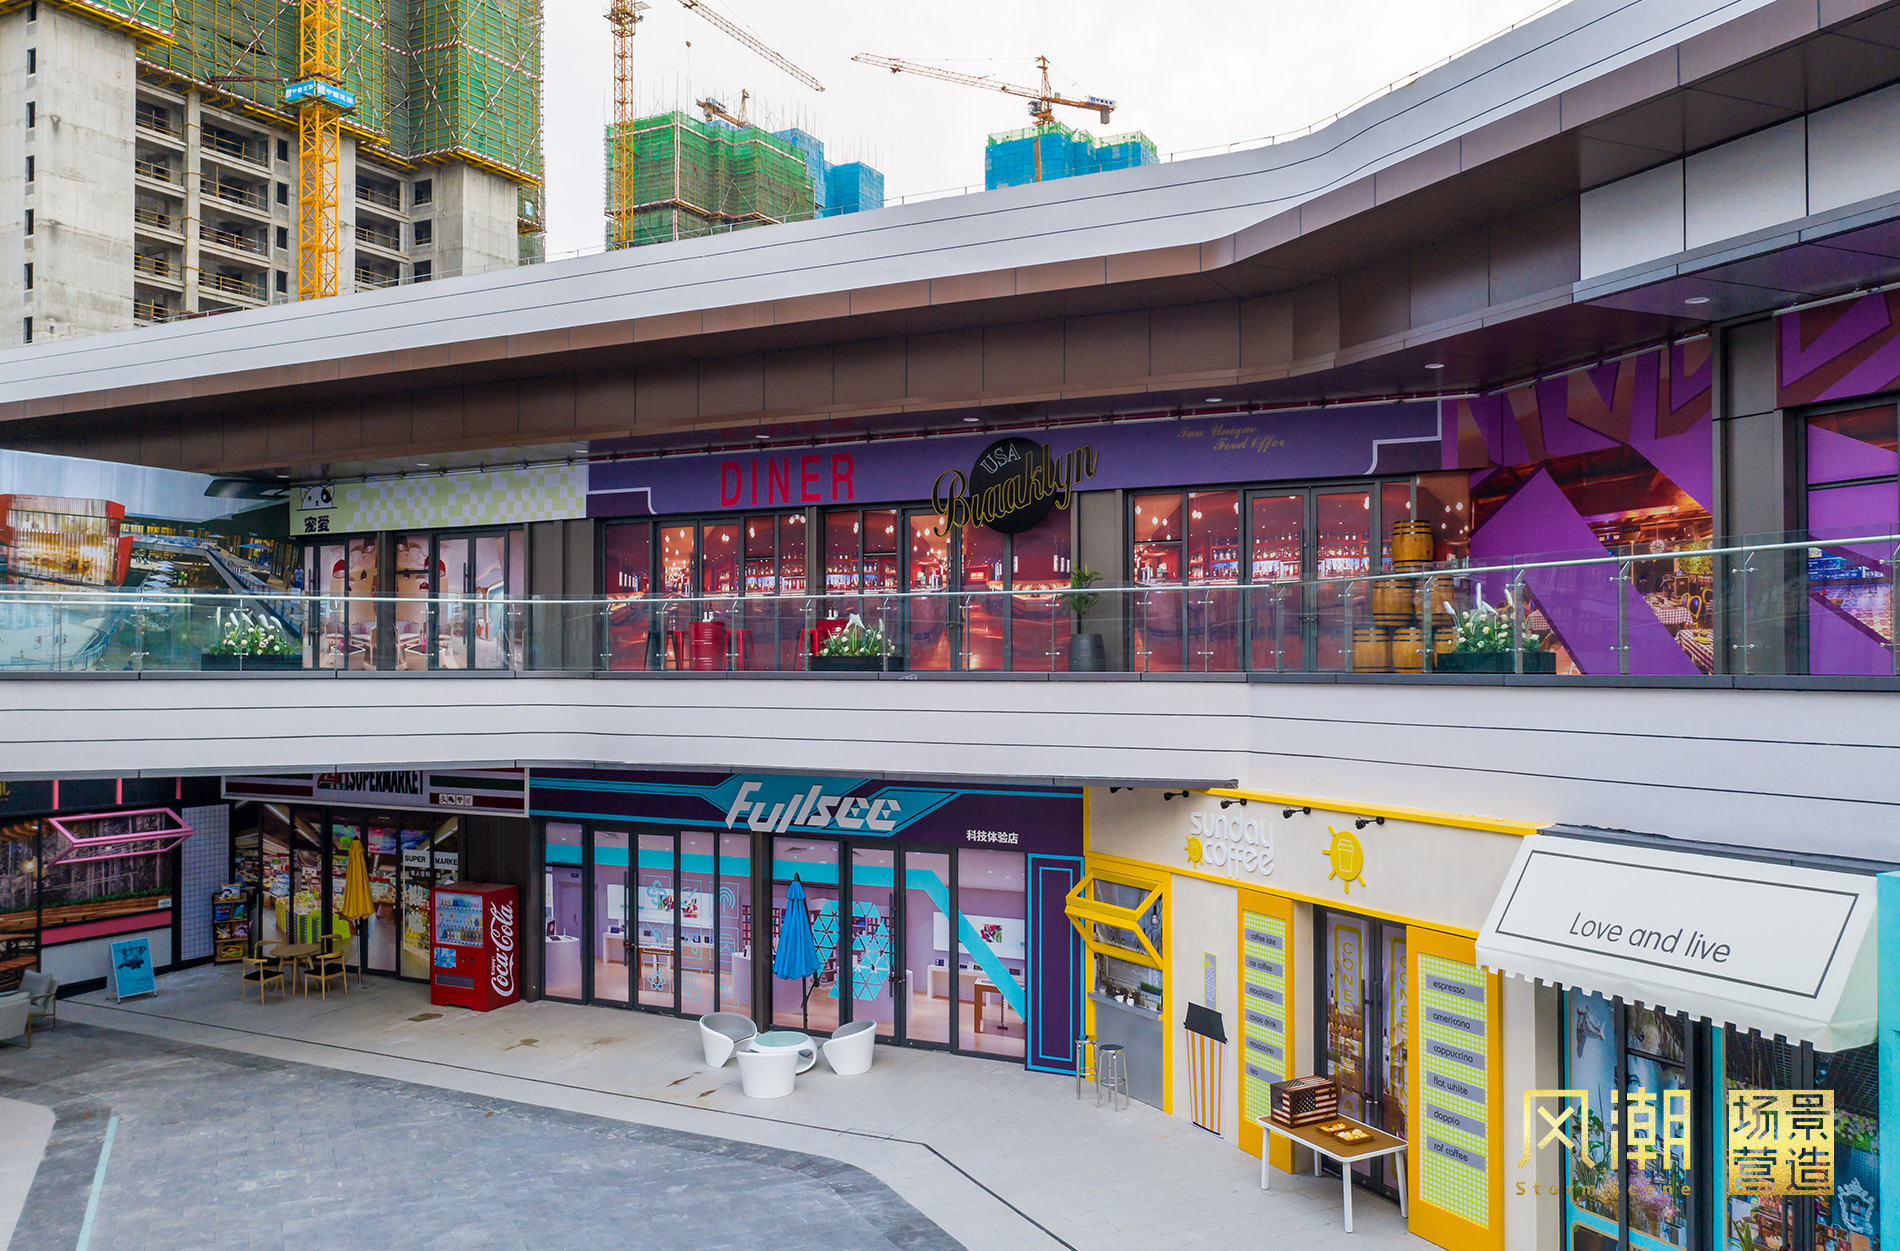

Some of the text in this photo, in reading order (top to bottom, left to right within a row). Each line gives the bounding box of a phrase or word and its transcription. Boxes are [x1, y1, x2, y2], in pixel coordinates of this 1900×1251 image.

[1213, 434, 1286, 453] Food Offer
[980, 443, 1022, 474] USA
[720, 452, 855, 507] DINER
[304, 515, 330, 533] 宠爱
[966, 829, 1019, 845] 科技体验店
[1190, 808, 1274, 857] sunday
[405, 854, 426, 863] SUPER
[1203, 840, 1275, 880] coffee
[1569, 912, 1731, 963] Love and live
[490, 901, 515, 997] Coca-Cola
[1433, 980, 1466, 996] espresso
[1263, 1019, 1277, 1029] drink
[1432, 1012, 1471, 1030] americano
[1433, 1045, 1474, 1063] cappuccino
[1433, 1075, 1469, 1096] flat white
[1433, 1110, 1460, 1126] doppio
[1433, 1143, 1469, 1162] raf coffee
